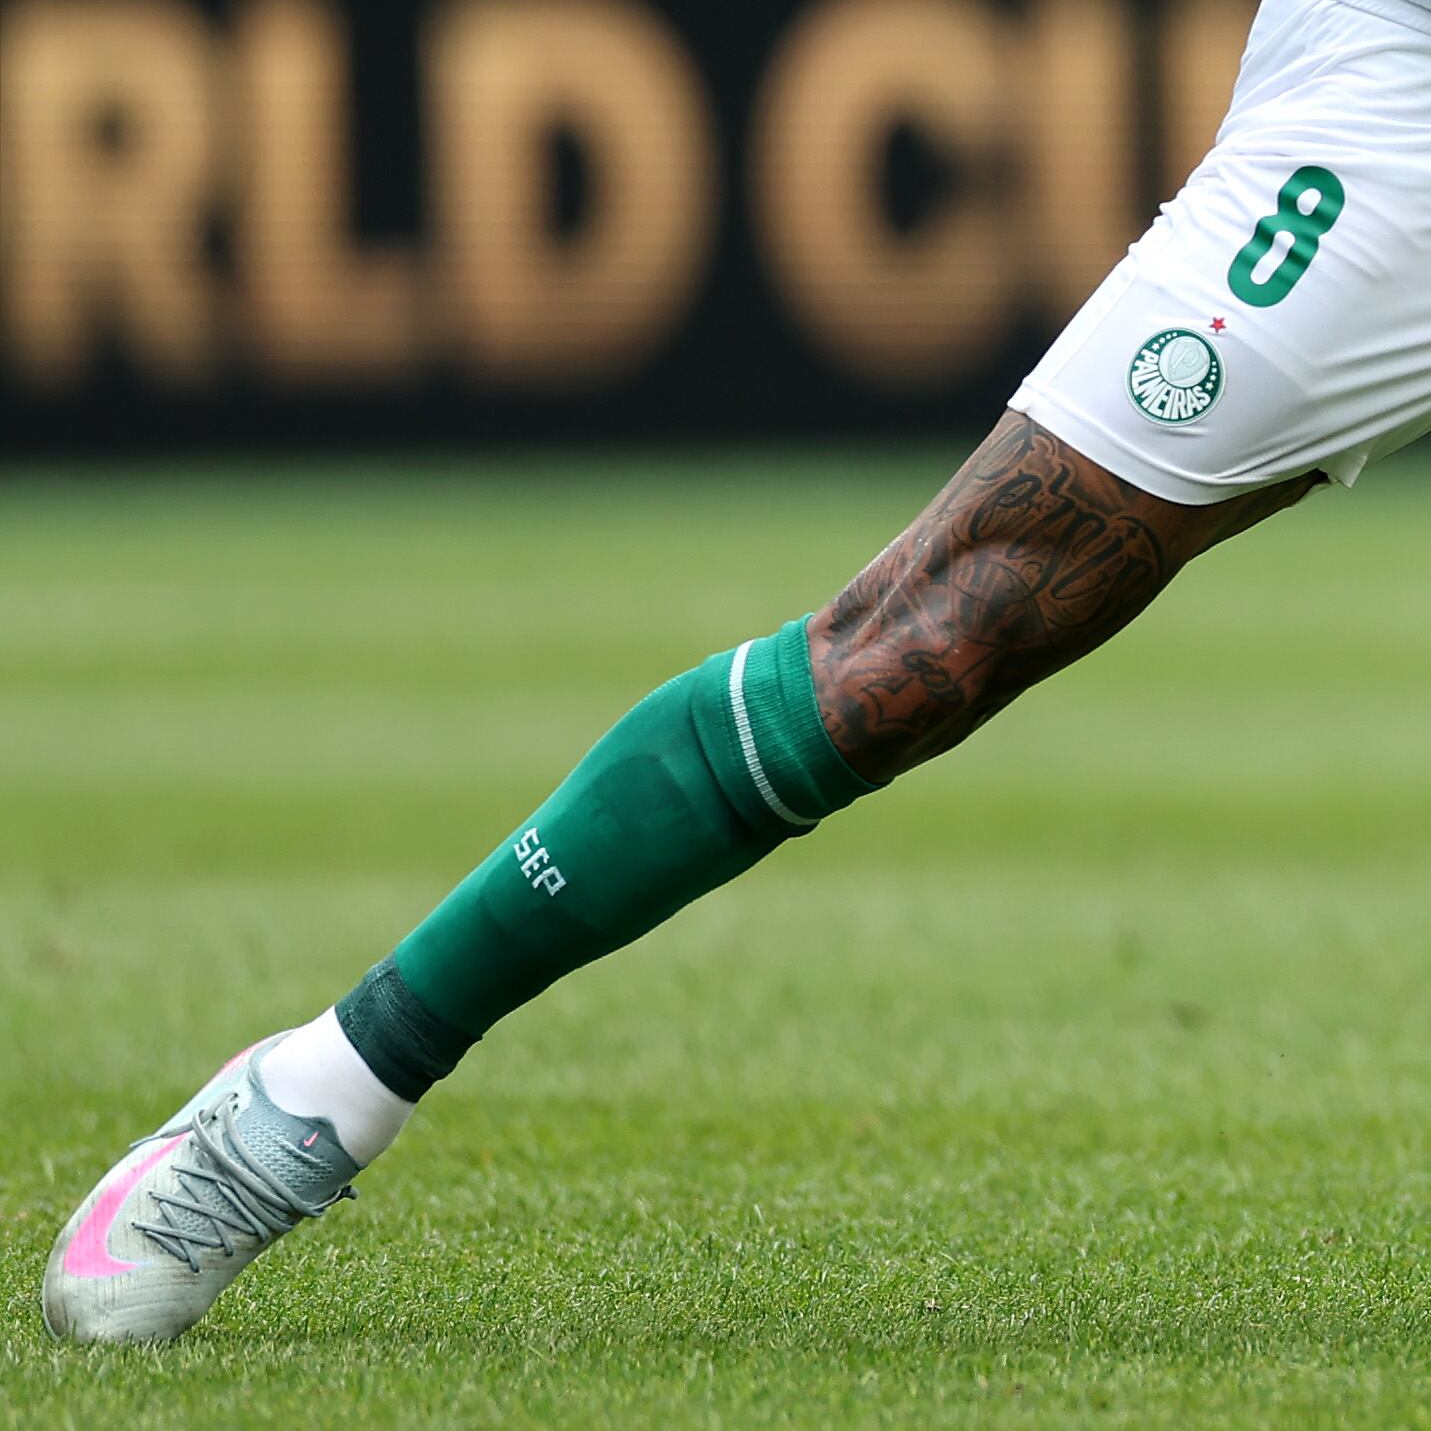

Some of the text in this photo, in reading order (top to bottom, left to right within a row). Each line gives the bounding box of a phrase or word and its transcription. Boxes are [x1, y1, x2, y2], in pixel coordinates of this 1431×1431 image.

[1227, 165, 1345, 308] 8
[1131, 348, 1211, 420] PALMEIRAS
[513, 827, 567, 897] SEP
